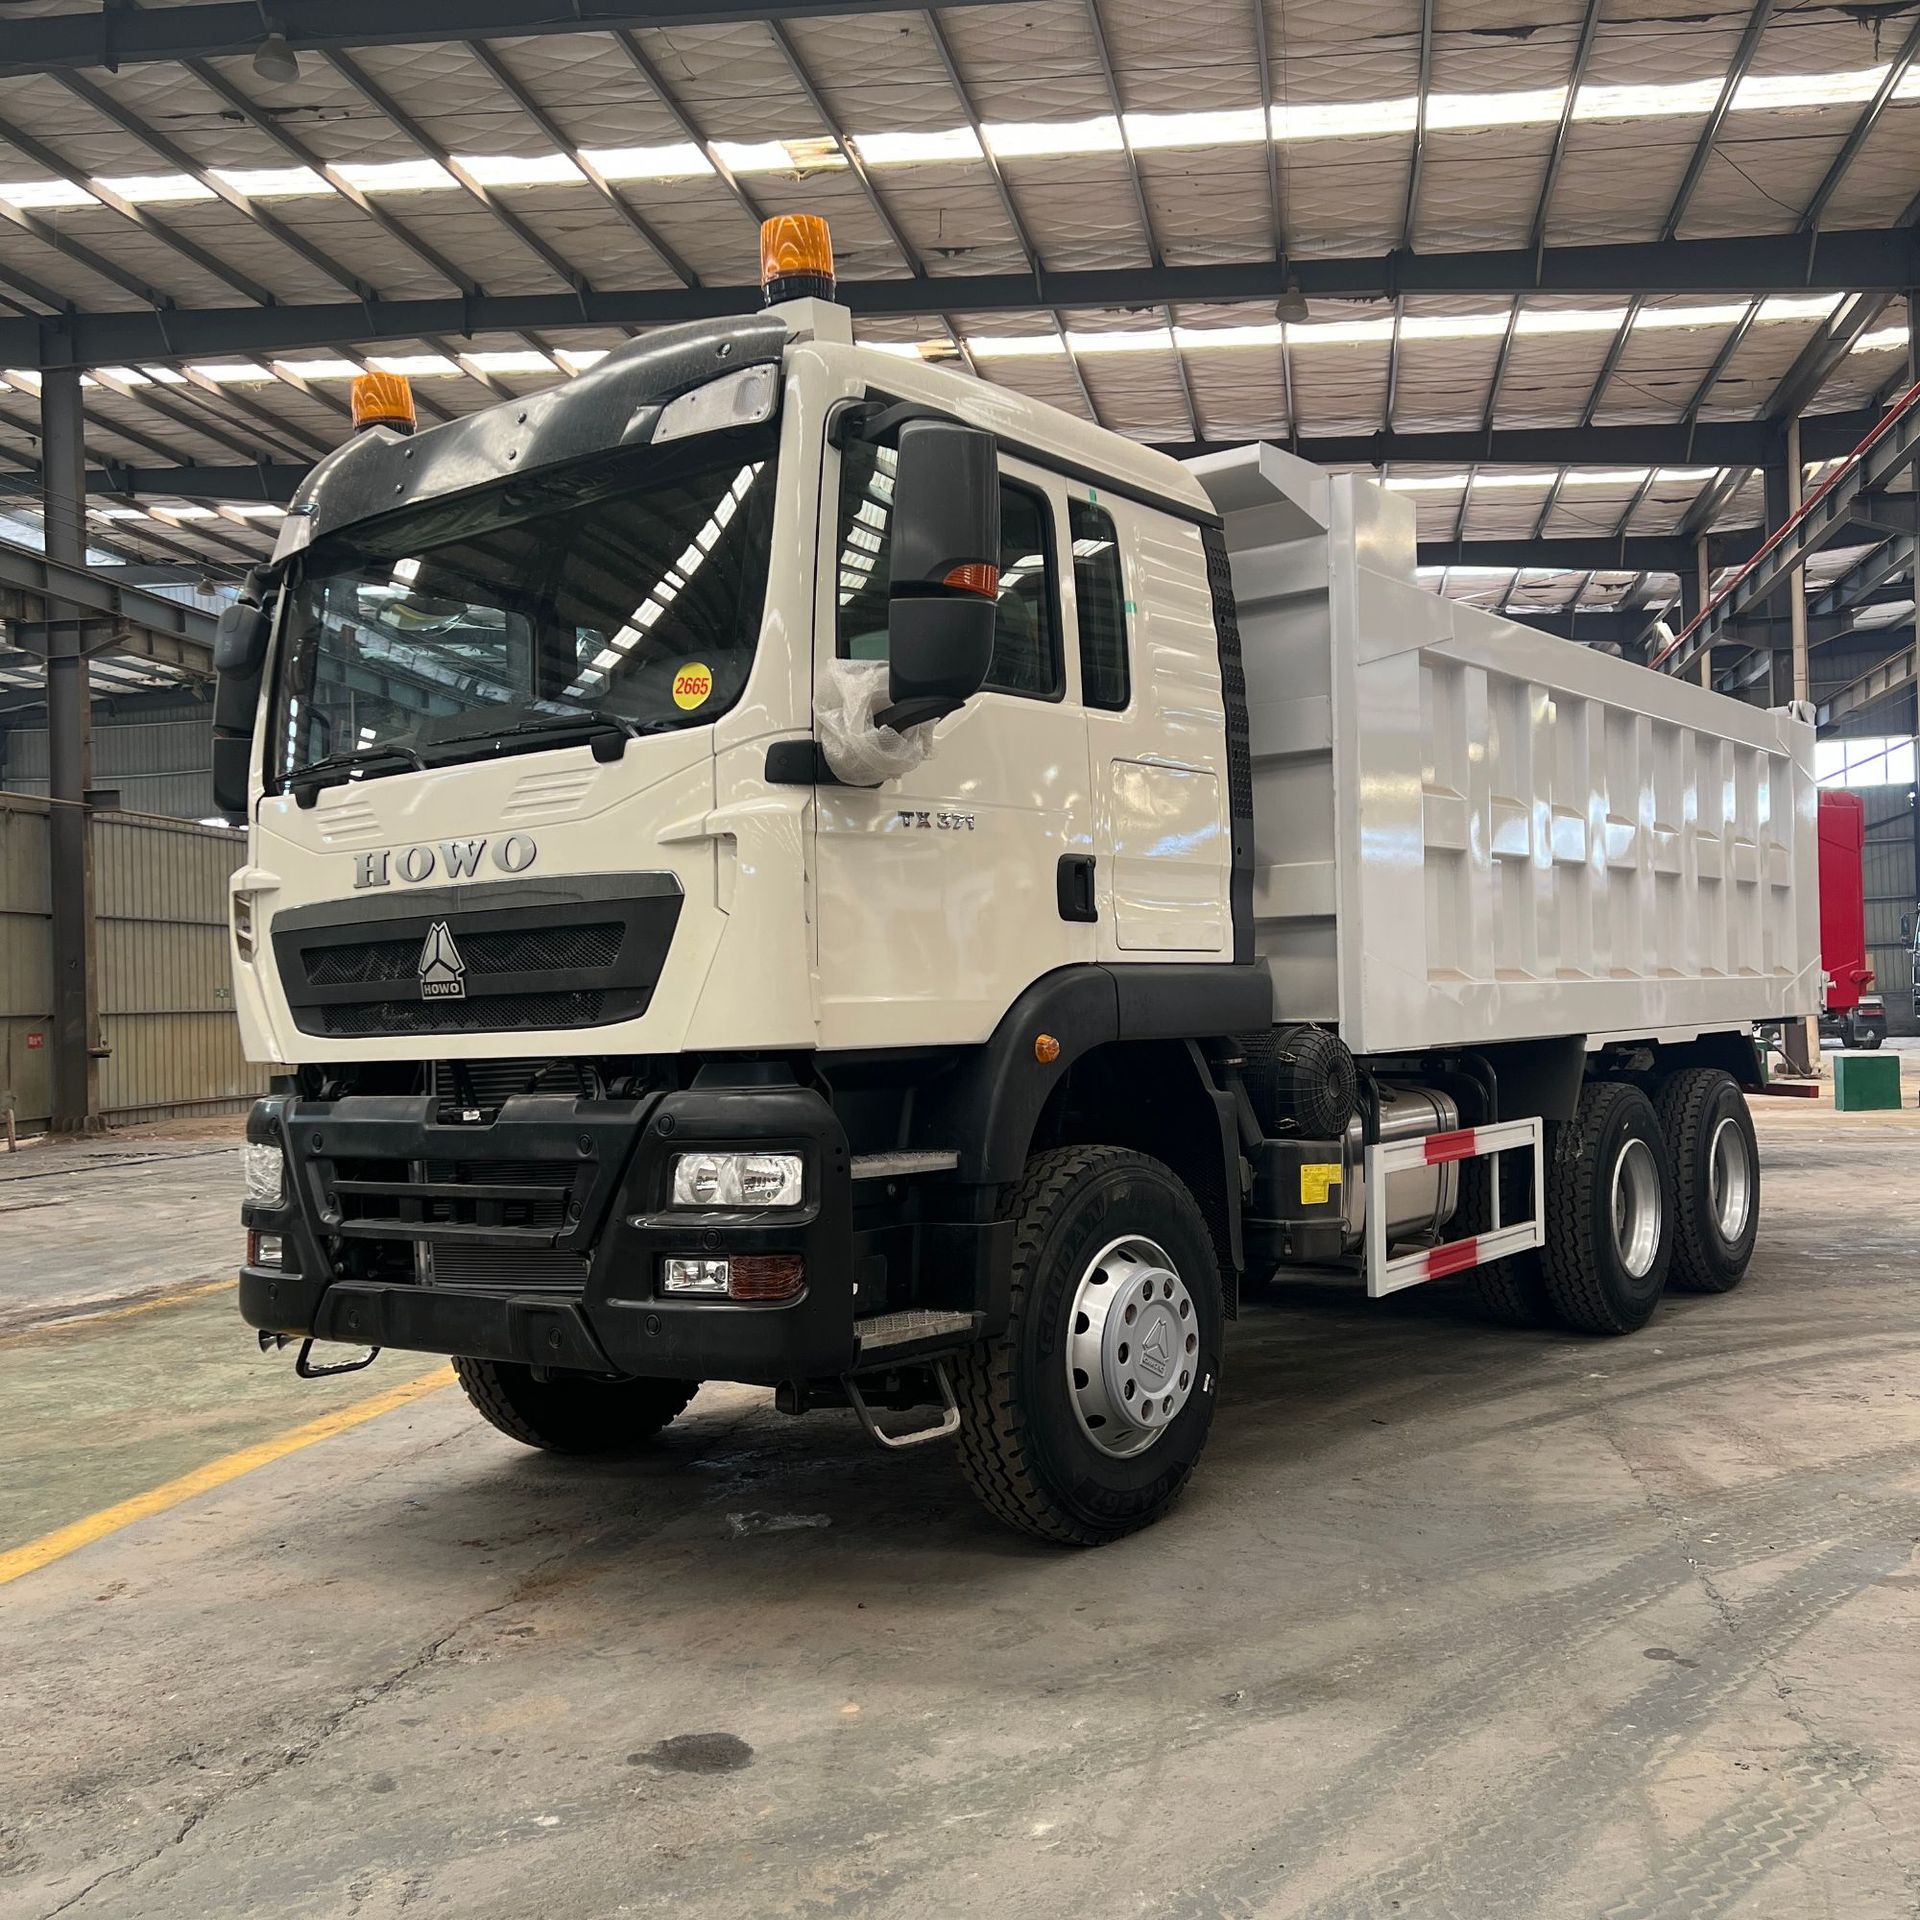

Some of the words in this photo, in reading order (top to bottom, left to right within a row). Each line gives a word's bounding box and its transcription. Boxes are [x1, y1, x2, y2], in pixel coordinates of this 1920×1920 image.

[675, 676, 710, 695] 2665
[897, 810, 932, 829] TX
[936, 812, 975, 831] 371
[353, 833, 538, 890] HOWO
[423, 982, 460, 995] HOWO
